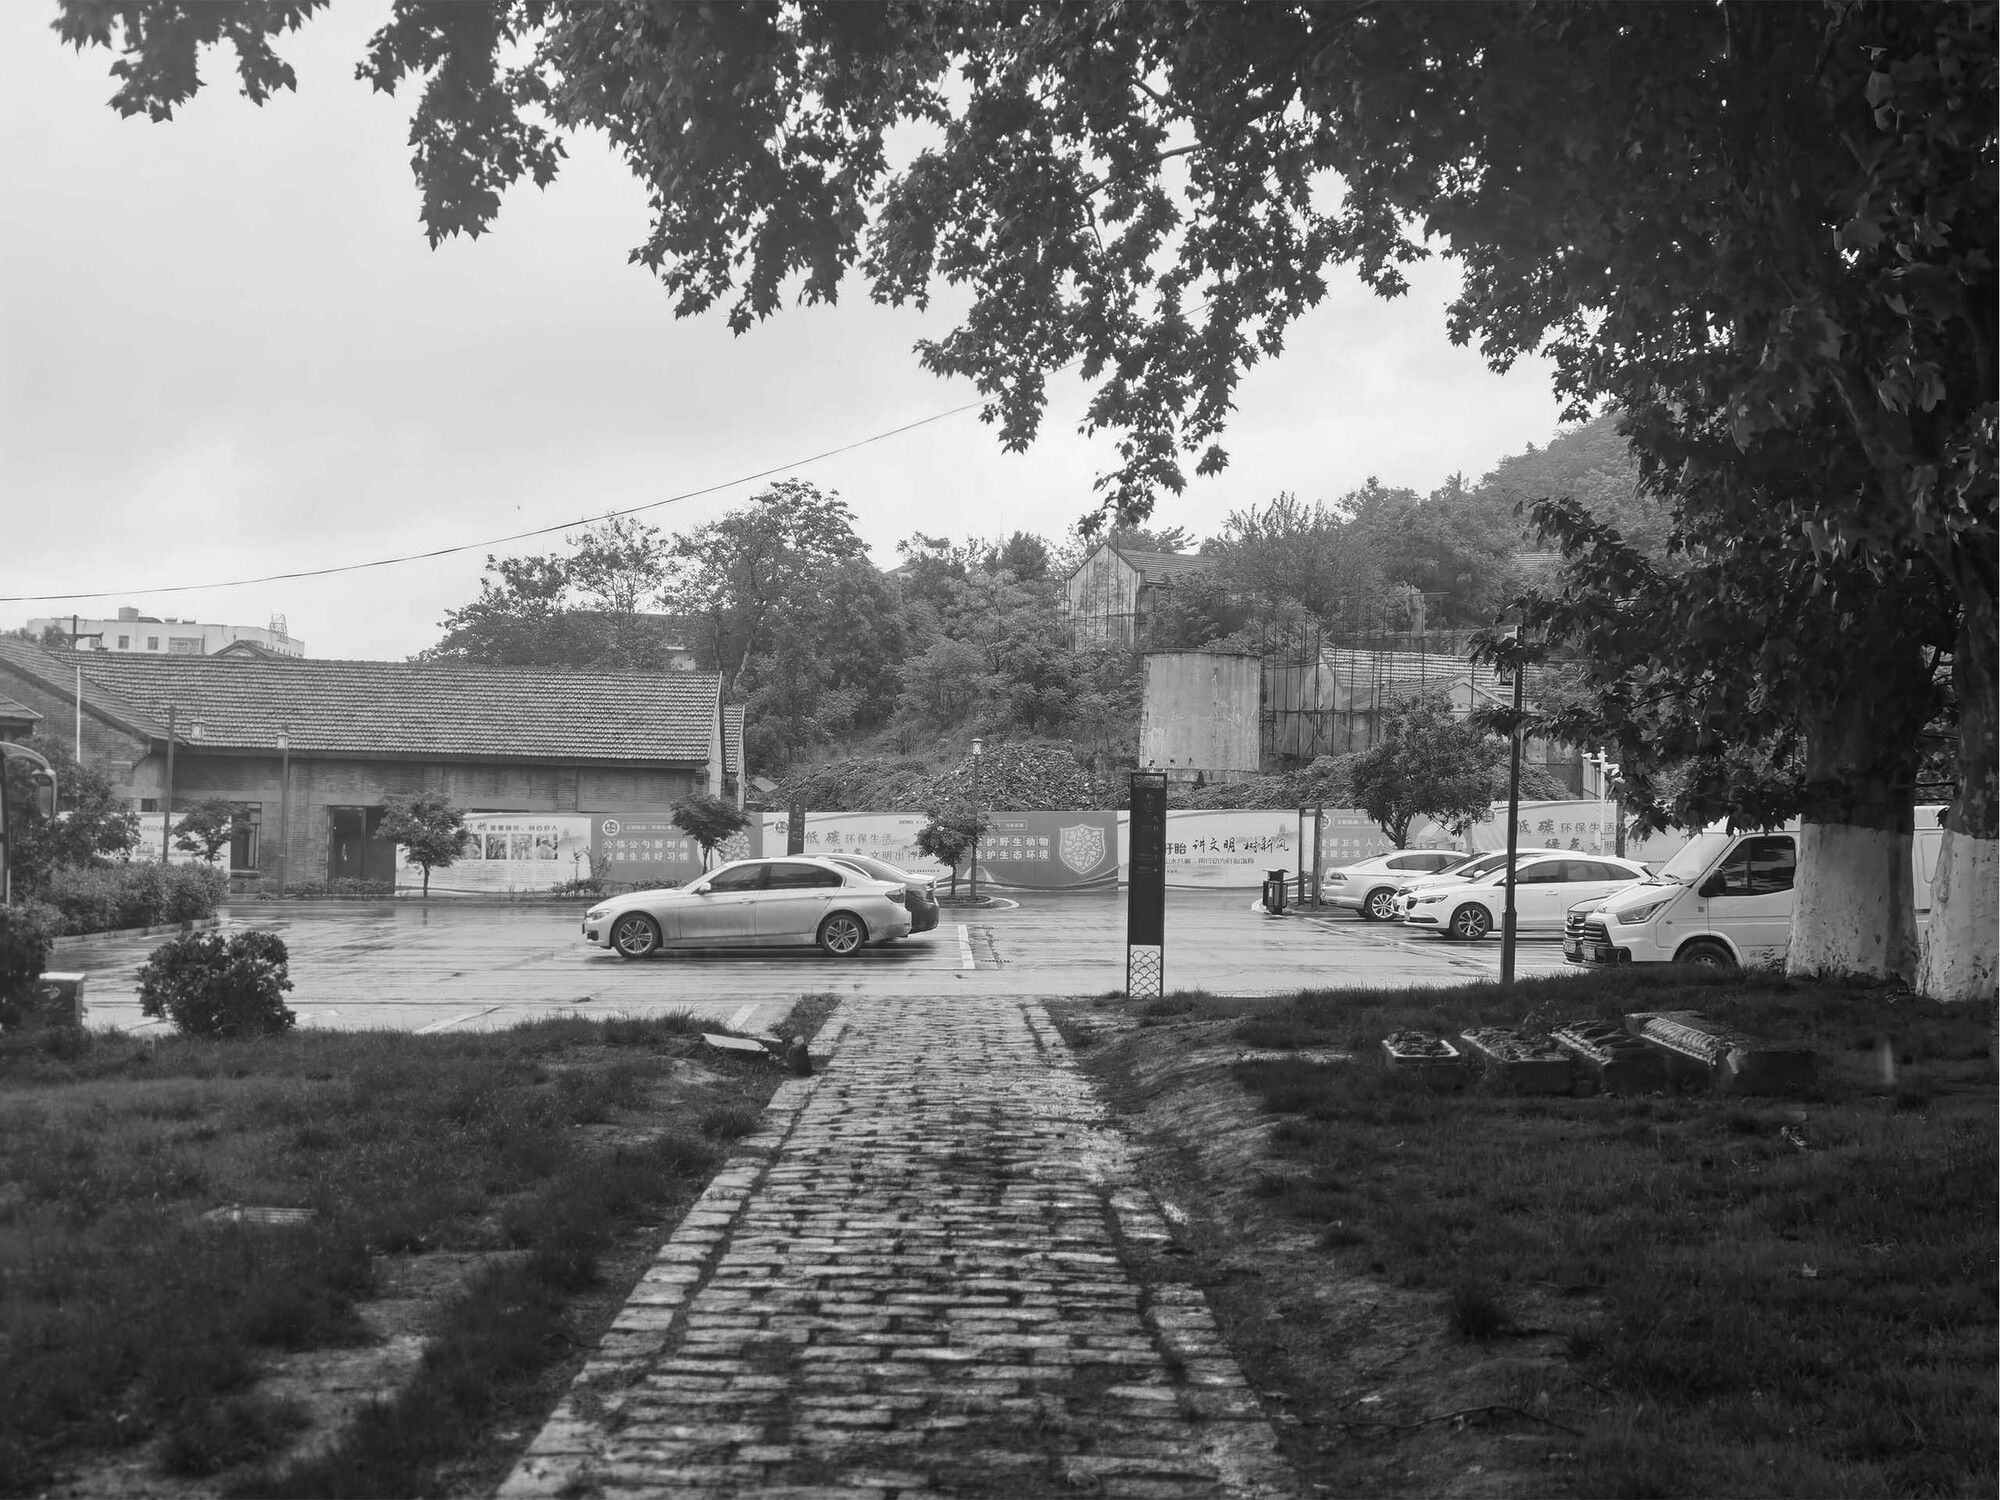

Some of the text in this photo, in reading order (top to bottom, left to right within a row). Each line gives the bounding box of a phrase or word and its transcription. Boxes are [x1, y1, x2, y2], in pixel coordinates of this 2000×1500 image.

[804, 830, 893, 845] 低碳环保生活
[1192, 836, 1236, 854] 讲文明
[1243, 836, 1290, 854] 树新风
[1544, 838, 1644, 851] 绿色文明行
